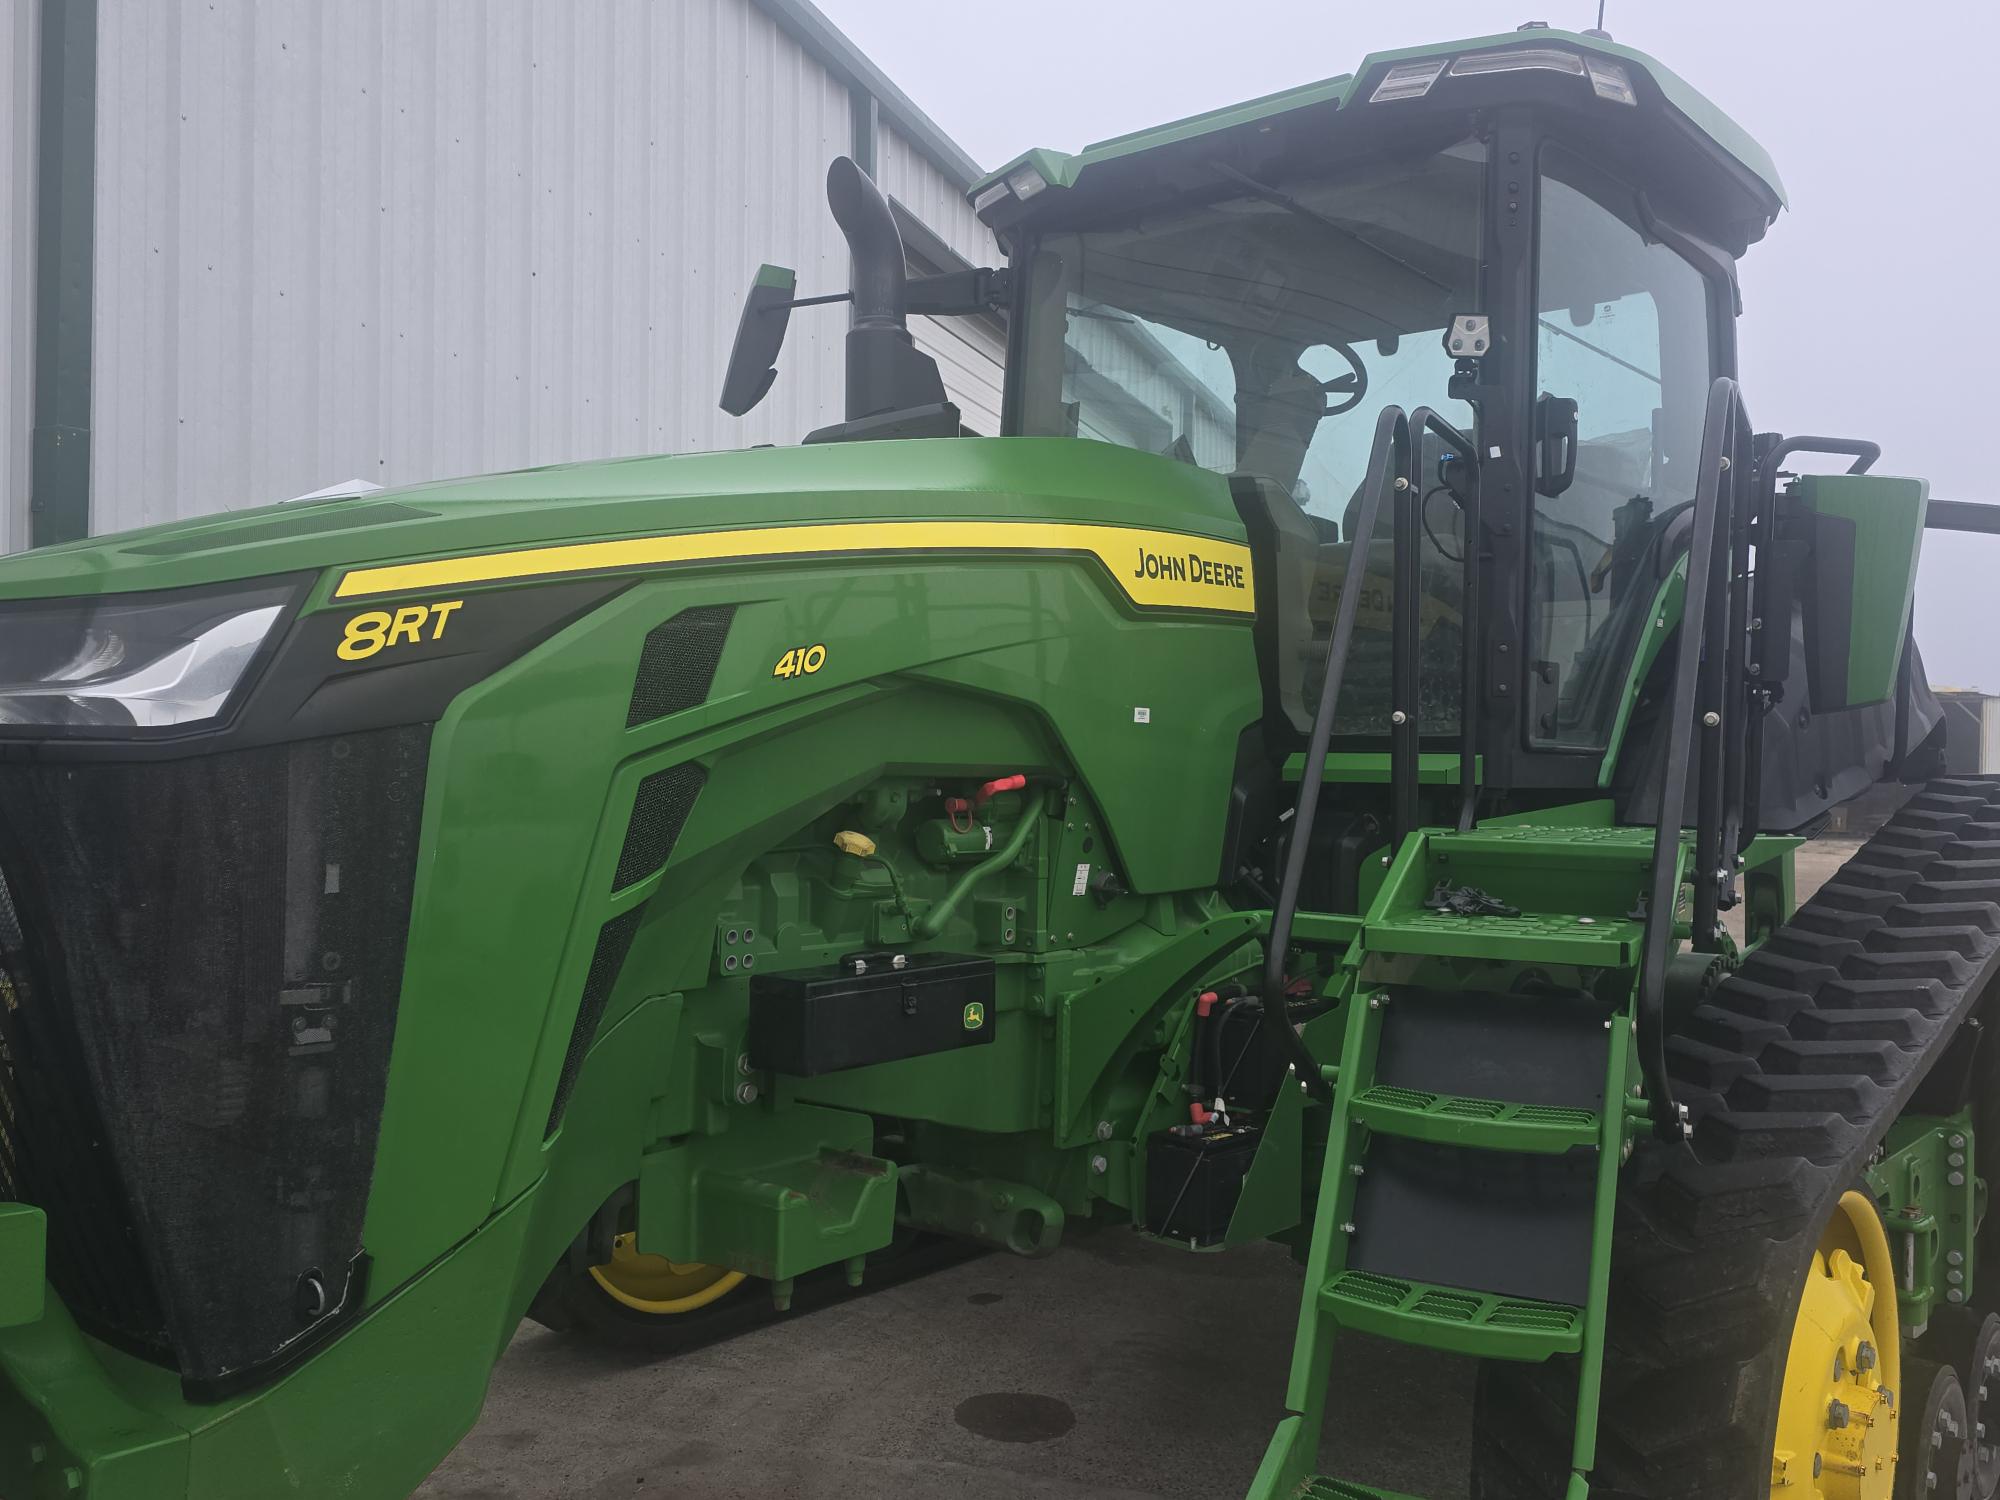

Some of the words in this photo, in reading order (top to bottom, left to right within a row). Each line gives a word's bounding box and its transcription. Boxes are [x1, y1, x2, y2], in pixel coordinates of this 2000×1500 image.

[1134, 547, 1186, 582] JOHN
[1188, 553, 1245, 589] DEERE
[336, 600, 464, 661] 8RT
[773, 644, 827, 679] 410
